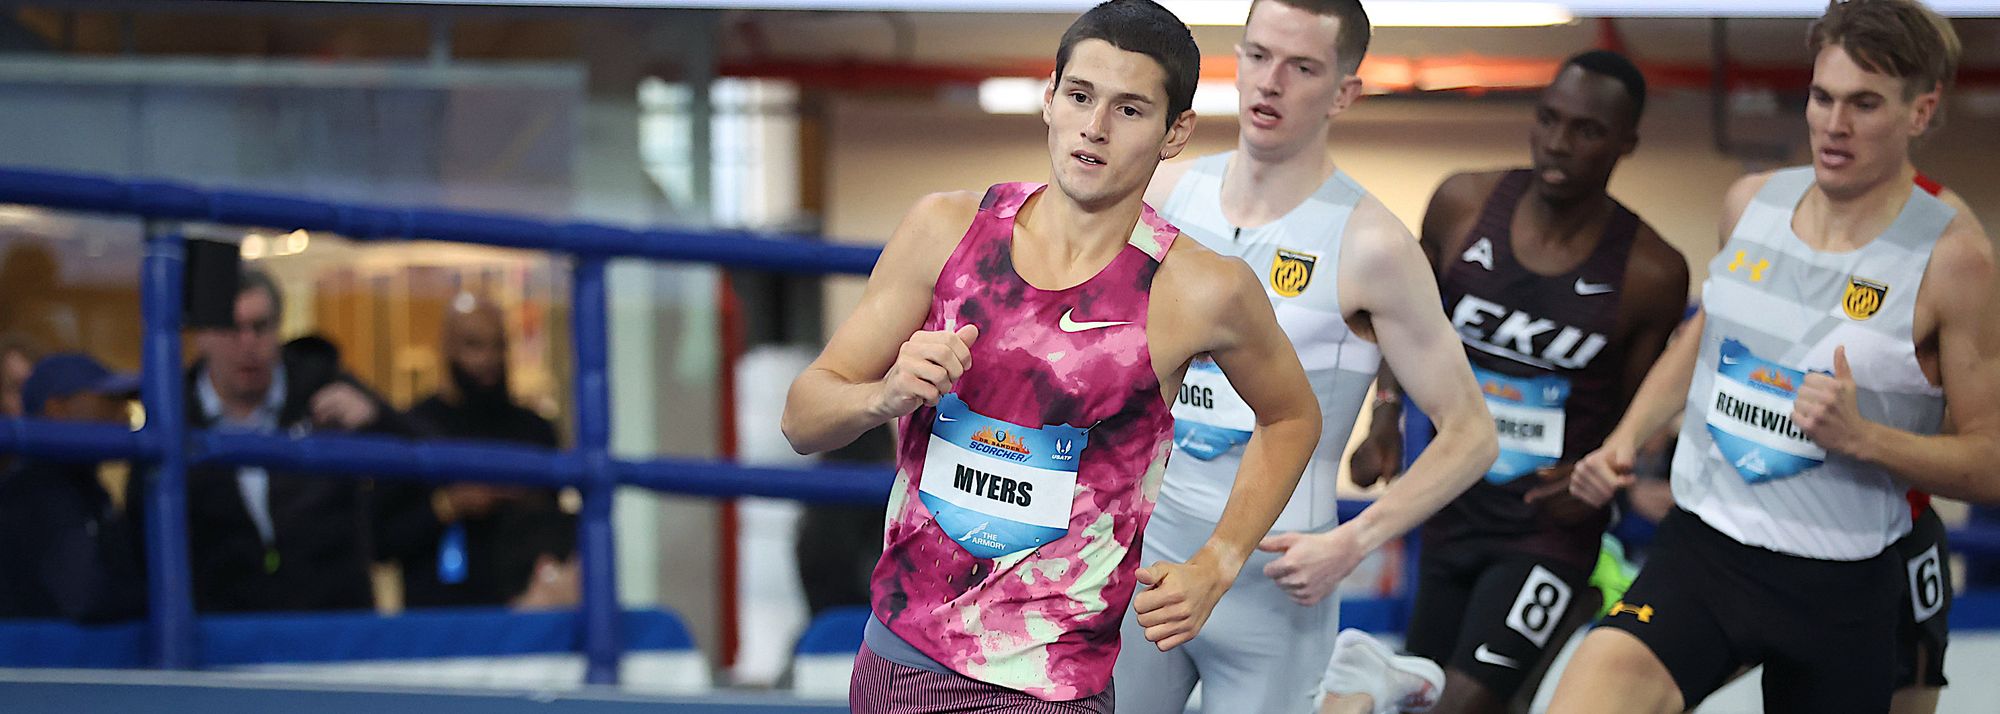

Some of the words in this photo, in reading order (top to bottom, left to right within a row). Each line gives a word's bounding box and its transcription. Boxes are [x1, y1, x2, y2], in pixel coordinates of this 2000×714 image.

[1451, 294, 1608, 369] EKU
[1180, 383, 1214, 409] OGG
[969, 440, 1028, 463] SCORCHER
[991, 441, 1021, 453] SANDER
[1051, 453, 1073, 461] USATF
[953, 463, 1033, 507] MYERS
[971, 536, 1006, 551] ARMORY
[982, 531, 998, 542] THE
[1916, 557, 1939, 609] 6
[1521, 582, 1560, 632] 8
